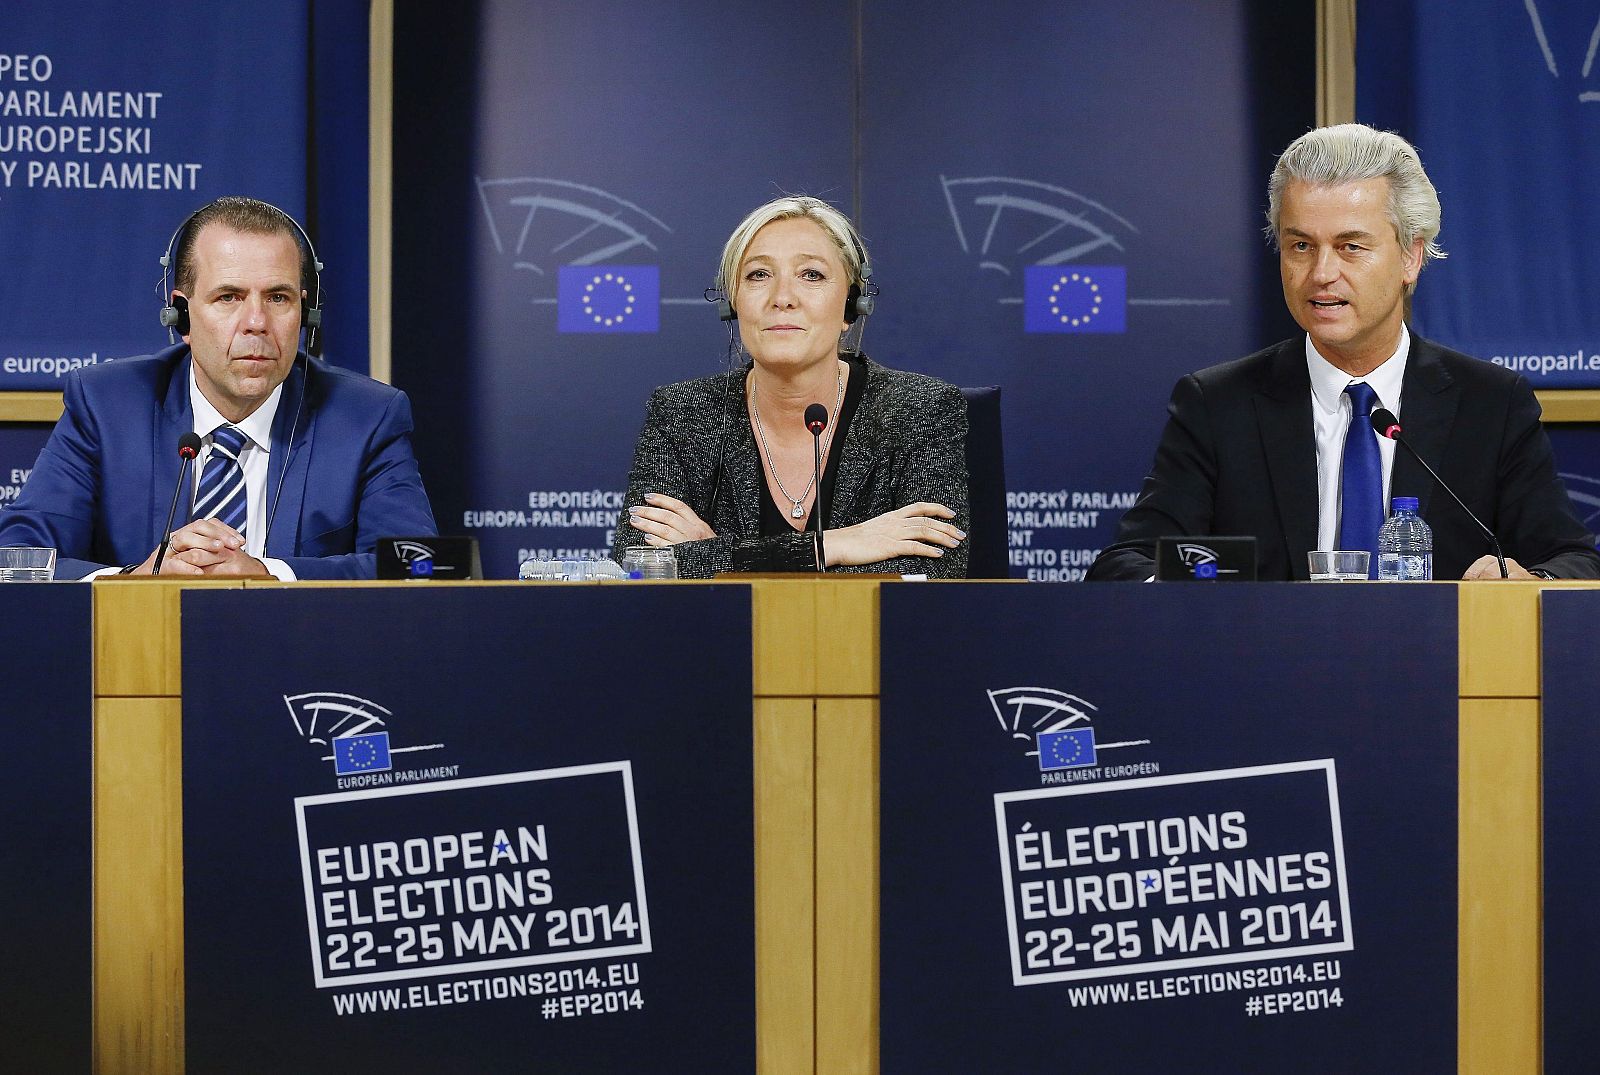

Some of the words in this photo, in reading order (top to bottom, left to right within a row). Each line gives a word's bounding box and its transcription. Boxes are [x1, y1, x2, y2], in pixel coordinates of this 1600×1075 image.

[0, 90, 162, 119] ARLAMENT
[28, 160, 202, 190] PARLAMENT
[1072, 492, 1140, 509] PARLAM
[337, 773, 393, 790] EUROPEAN
[395, 765, 460, 783] PARLIAMENT
[1041, 768, 1102, 785] PARLEMENT
[1104, 761, 1160, 779] EUROPÉEN
[317, 824, 549, 886] EUROPEAN
[1015, 811, 1248, 872] ÉLECTIONS
[322, 868, 554, 928] ELECTIONS
[1020, 851, 1332, 920] EUROPÉENNES
[326, 923, 444, 971] 22-25
[452, 912, 537, 958] MAY
[545, 901, 639, 948] 2014
[1024, 919, 1142, 969] 22-25
[1152, 911, 1230, 955] MAI
[1240, 900, 1337, 947] 2014
[333, 962, 640, 1016] WWW.ELECTIONS2014.EU
[541, 988, 645, 1020] #EP2014
[1068, 960, 1341, 1008] WWW.ELECTIONS2014.EU
[1246, 987, 1344, 1017] #EP2014
